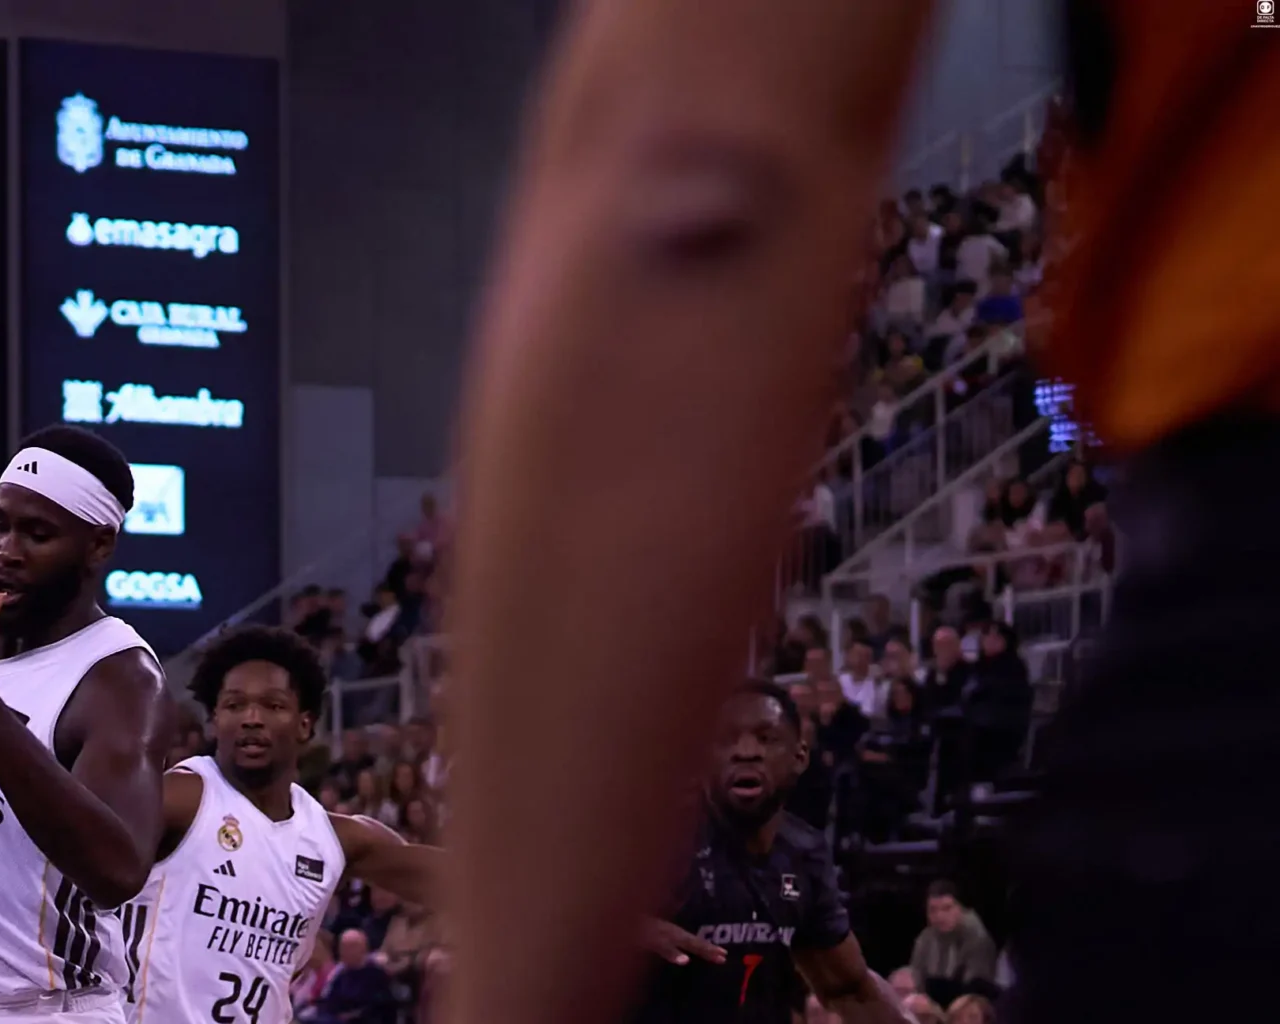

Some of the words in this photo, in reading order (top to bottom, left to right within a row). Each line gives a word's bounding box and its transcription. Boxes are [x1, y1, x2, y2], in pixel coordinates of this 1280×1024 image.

[193, 883, 313, 938] Emirate
[207, 926, 243, 954] FLY
[738, 954, 764, 1006] 7
